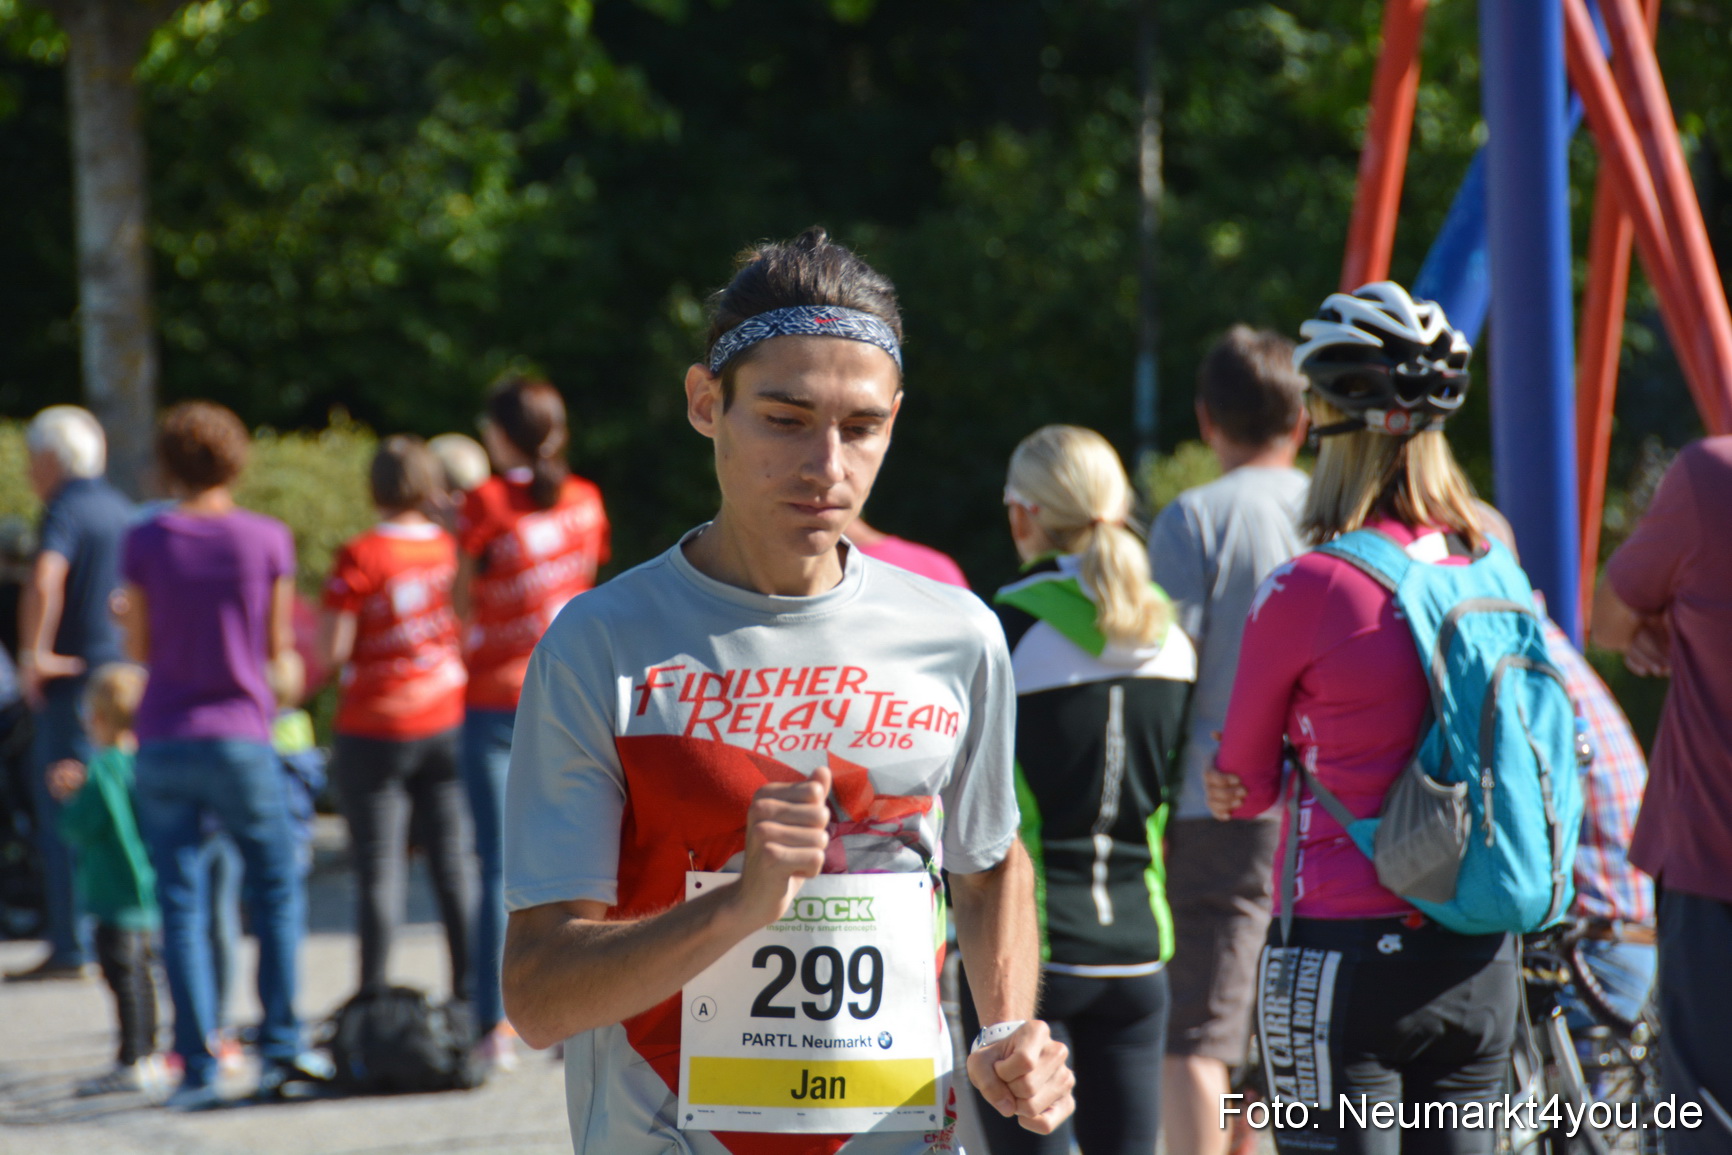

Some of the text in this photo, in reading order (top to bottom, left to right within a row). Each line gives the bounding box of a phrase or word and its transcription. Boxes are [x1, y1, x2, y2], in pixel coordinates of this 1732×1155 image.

[635, 665, 868, 716] FINISHER
[683, 690, 960, 742] RELAY TEAM
[753, 730, 914, 757] ROTH 2016
[766, 923, 877, 933] inspired by smart concepts
[750, 945, 884, 1021] 299
[698, 1002, 708, 1016] A
[742, 1033, 872, 1048] PARTL Neumarkt
[790, 1069, 846, 1099] Jan
